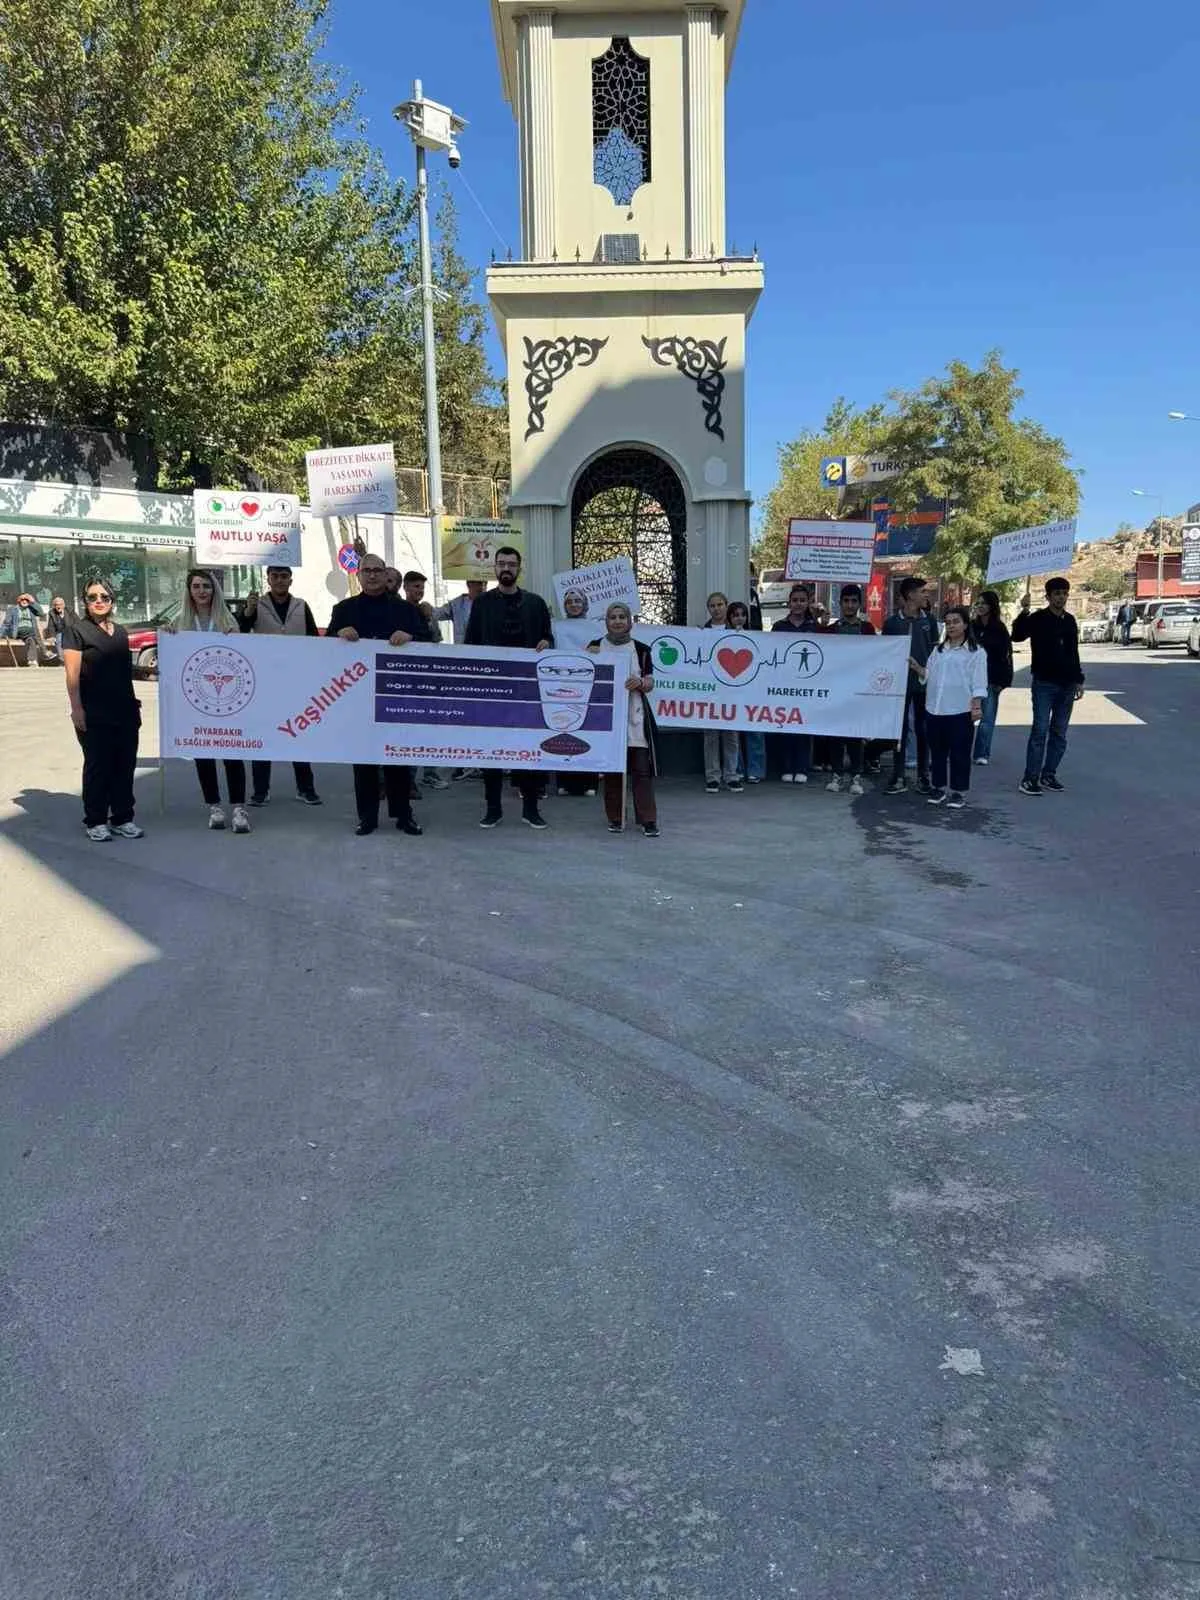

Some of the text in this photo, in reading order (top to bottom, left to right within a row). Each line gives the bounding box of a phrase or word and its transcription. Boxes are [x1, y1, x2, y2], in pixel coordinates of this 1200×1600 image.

[209, 529, 288, 545] MUTLU YAŞA
[678, 681, 717, 693] BESLEN
[767, 686, 830, 698] HAREKET ET
[277, 660, 370, 739] Yaşlılıkta
[657, 699, 804, 729] MUTLU YAŞA
[193, 725, 243, 737] DİYARBAKIR
[183, 736, 212, 748] SAĞLIK
[212, 737, 264, 749] MÜDÜRLÜĞÜ
[384, 744, 484, 756] kaderiniz
